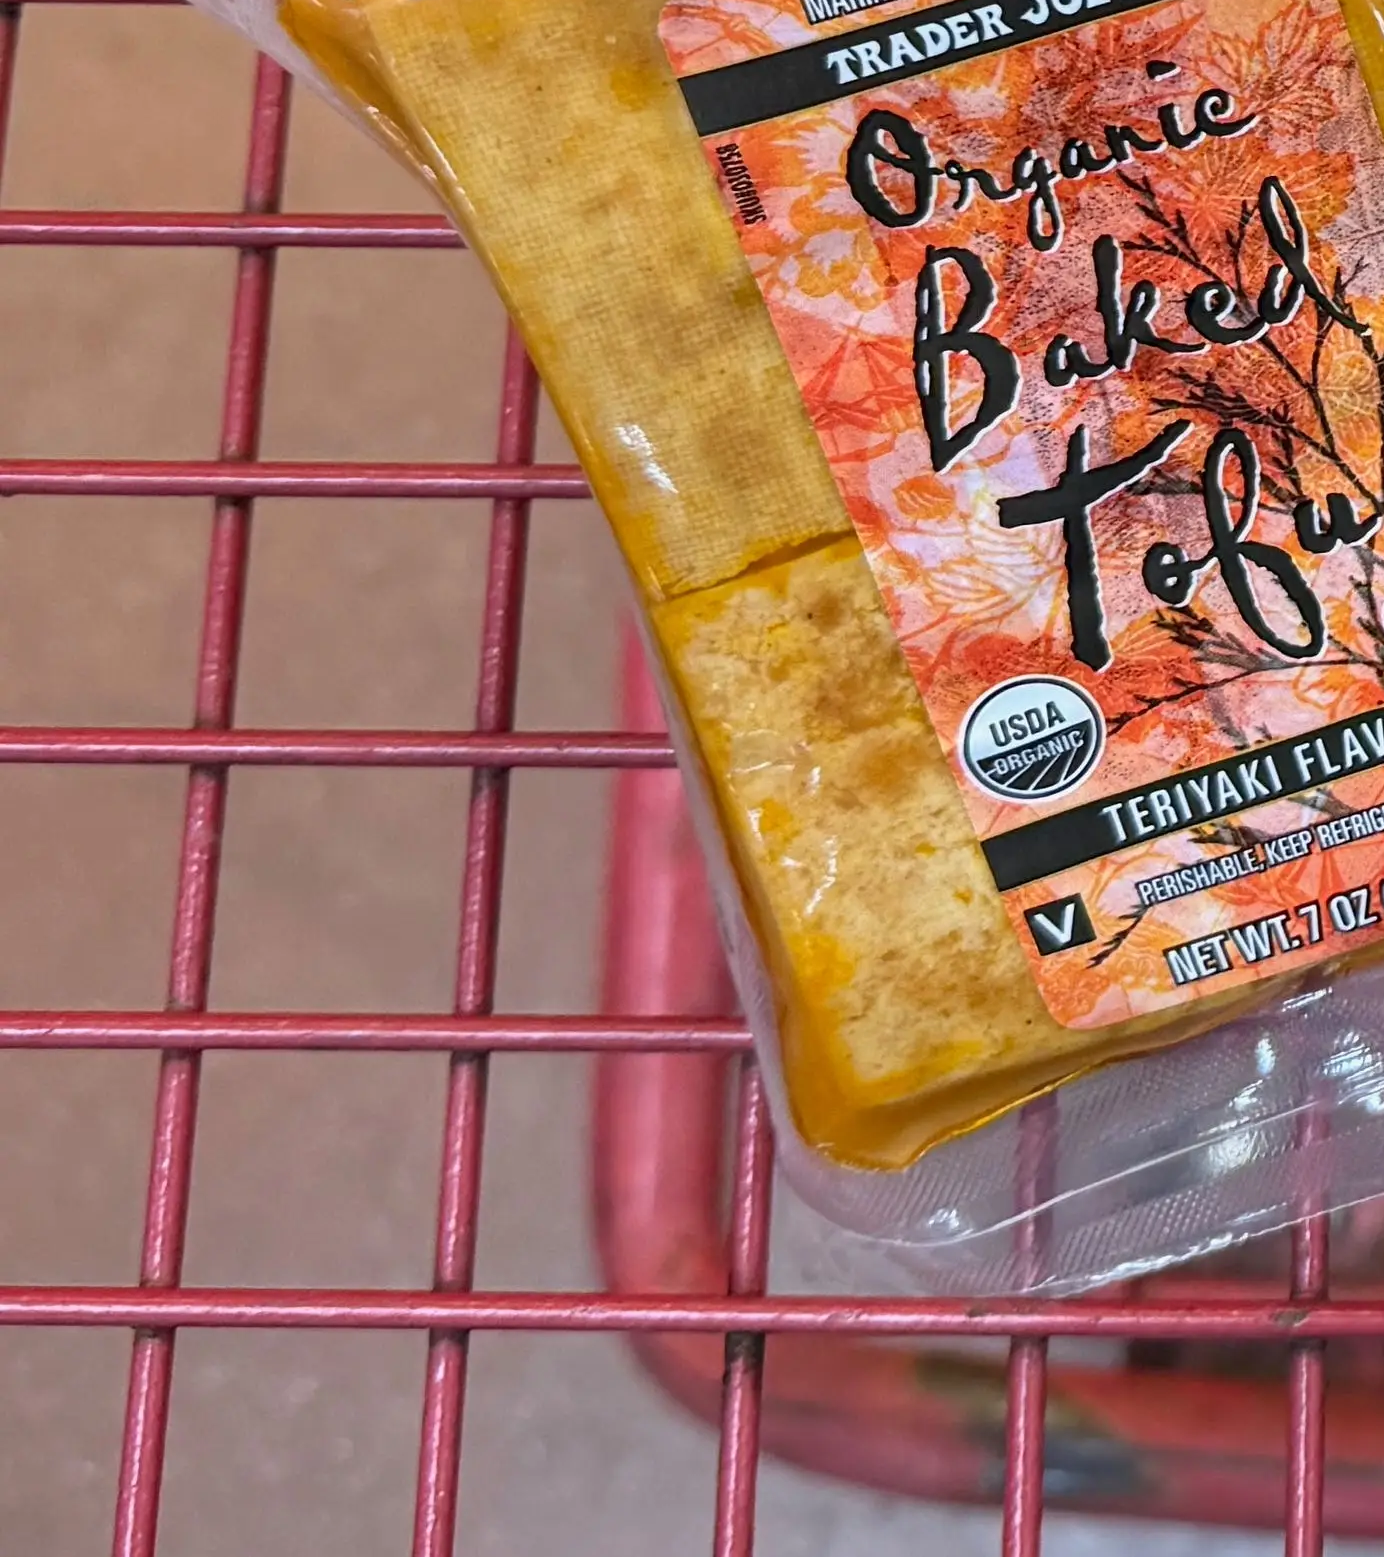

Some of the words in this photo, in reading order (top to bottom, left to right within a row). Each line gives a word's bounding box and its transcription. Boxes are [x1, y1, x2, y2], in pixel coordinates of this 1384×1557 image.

[825, 2, 1015, 86] TRADER
[845, 59, 1257, 252] Organic
[913, 175, 1373, 474] Baked
[996, 420, 1384, 673] Tofu
[989, 705, 1067, 750] USDA
[993, 729, 1087, 776] ORGANIC
[1101, 755, 1283, 843] TERIYAKI
[1137, 849, 1266, 907] PERISHABLE,
[1265, 829, 1314, 866] KEEP
[1164, 934, 1234, 988] NET
[1234, 914, 1301, 965] WT.
[1300, 904, 1326, 946] 7
[1329, 887, 1379, 935] OZ
